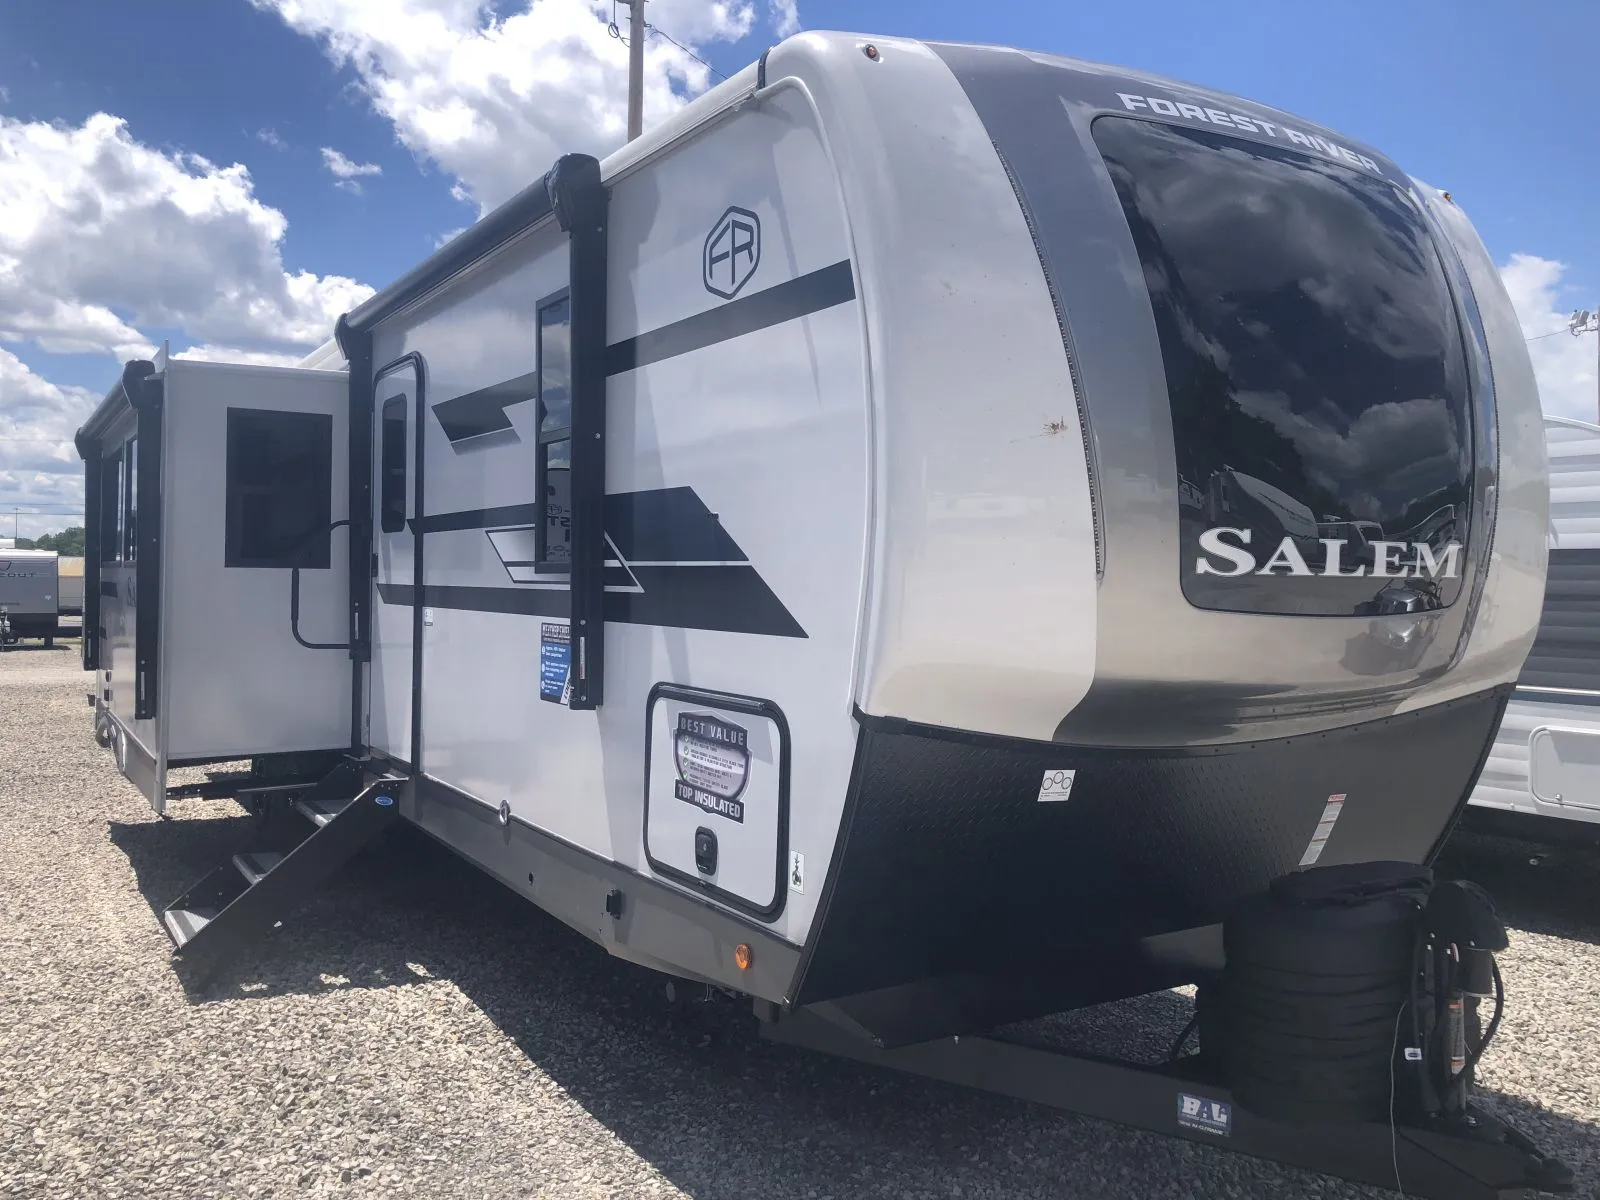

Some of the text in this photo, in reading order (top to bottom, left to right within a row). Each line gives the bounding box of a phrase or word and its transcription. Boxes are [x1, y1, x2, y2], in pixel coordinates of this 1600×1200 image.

[1115, 92, 1384, 176] FOREST RIVER
[1196, 526, 1463, 578] SALEM
[680, 717, 745, 746] BEST VALUE
[678, 783, 741, 818] TOP INSULATED
